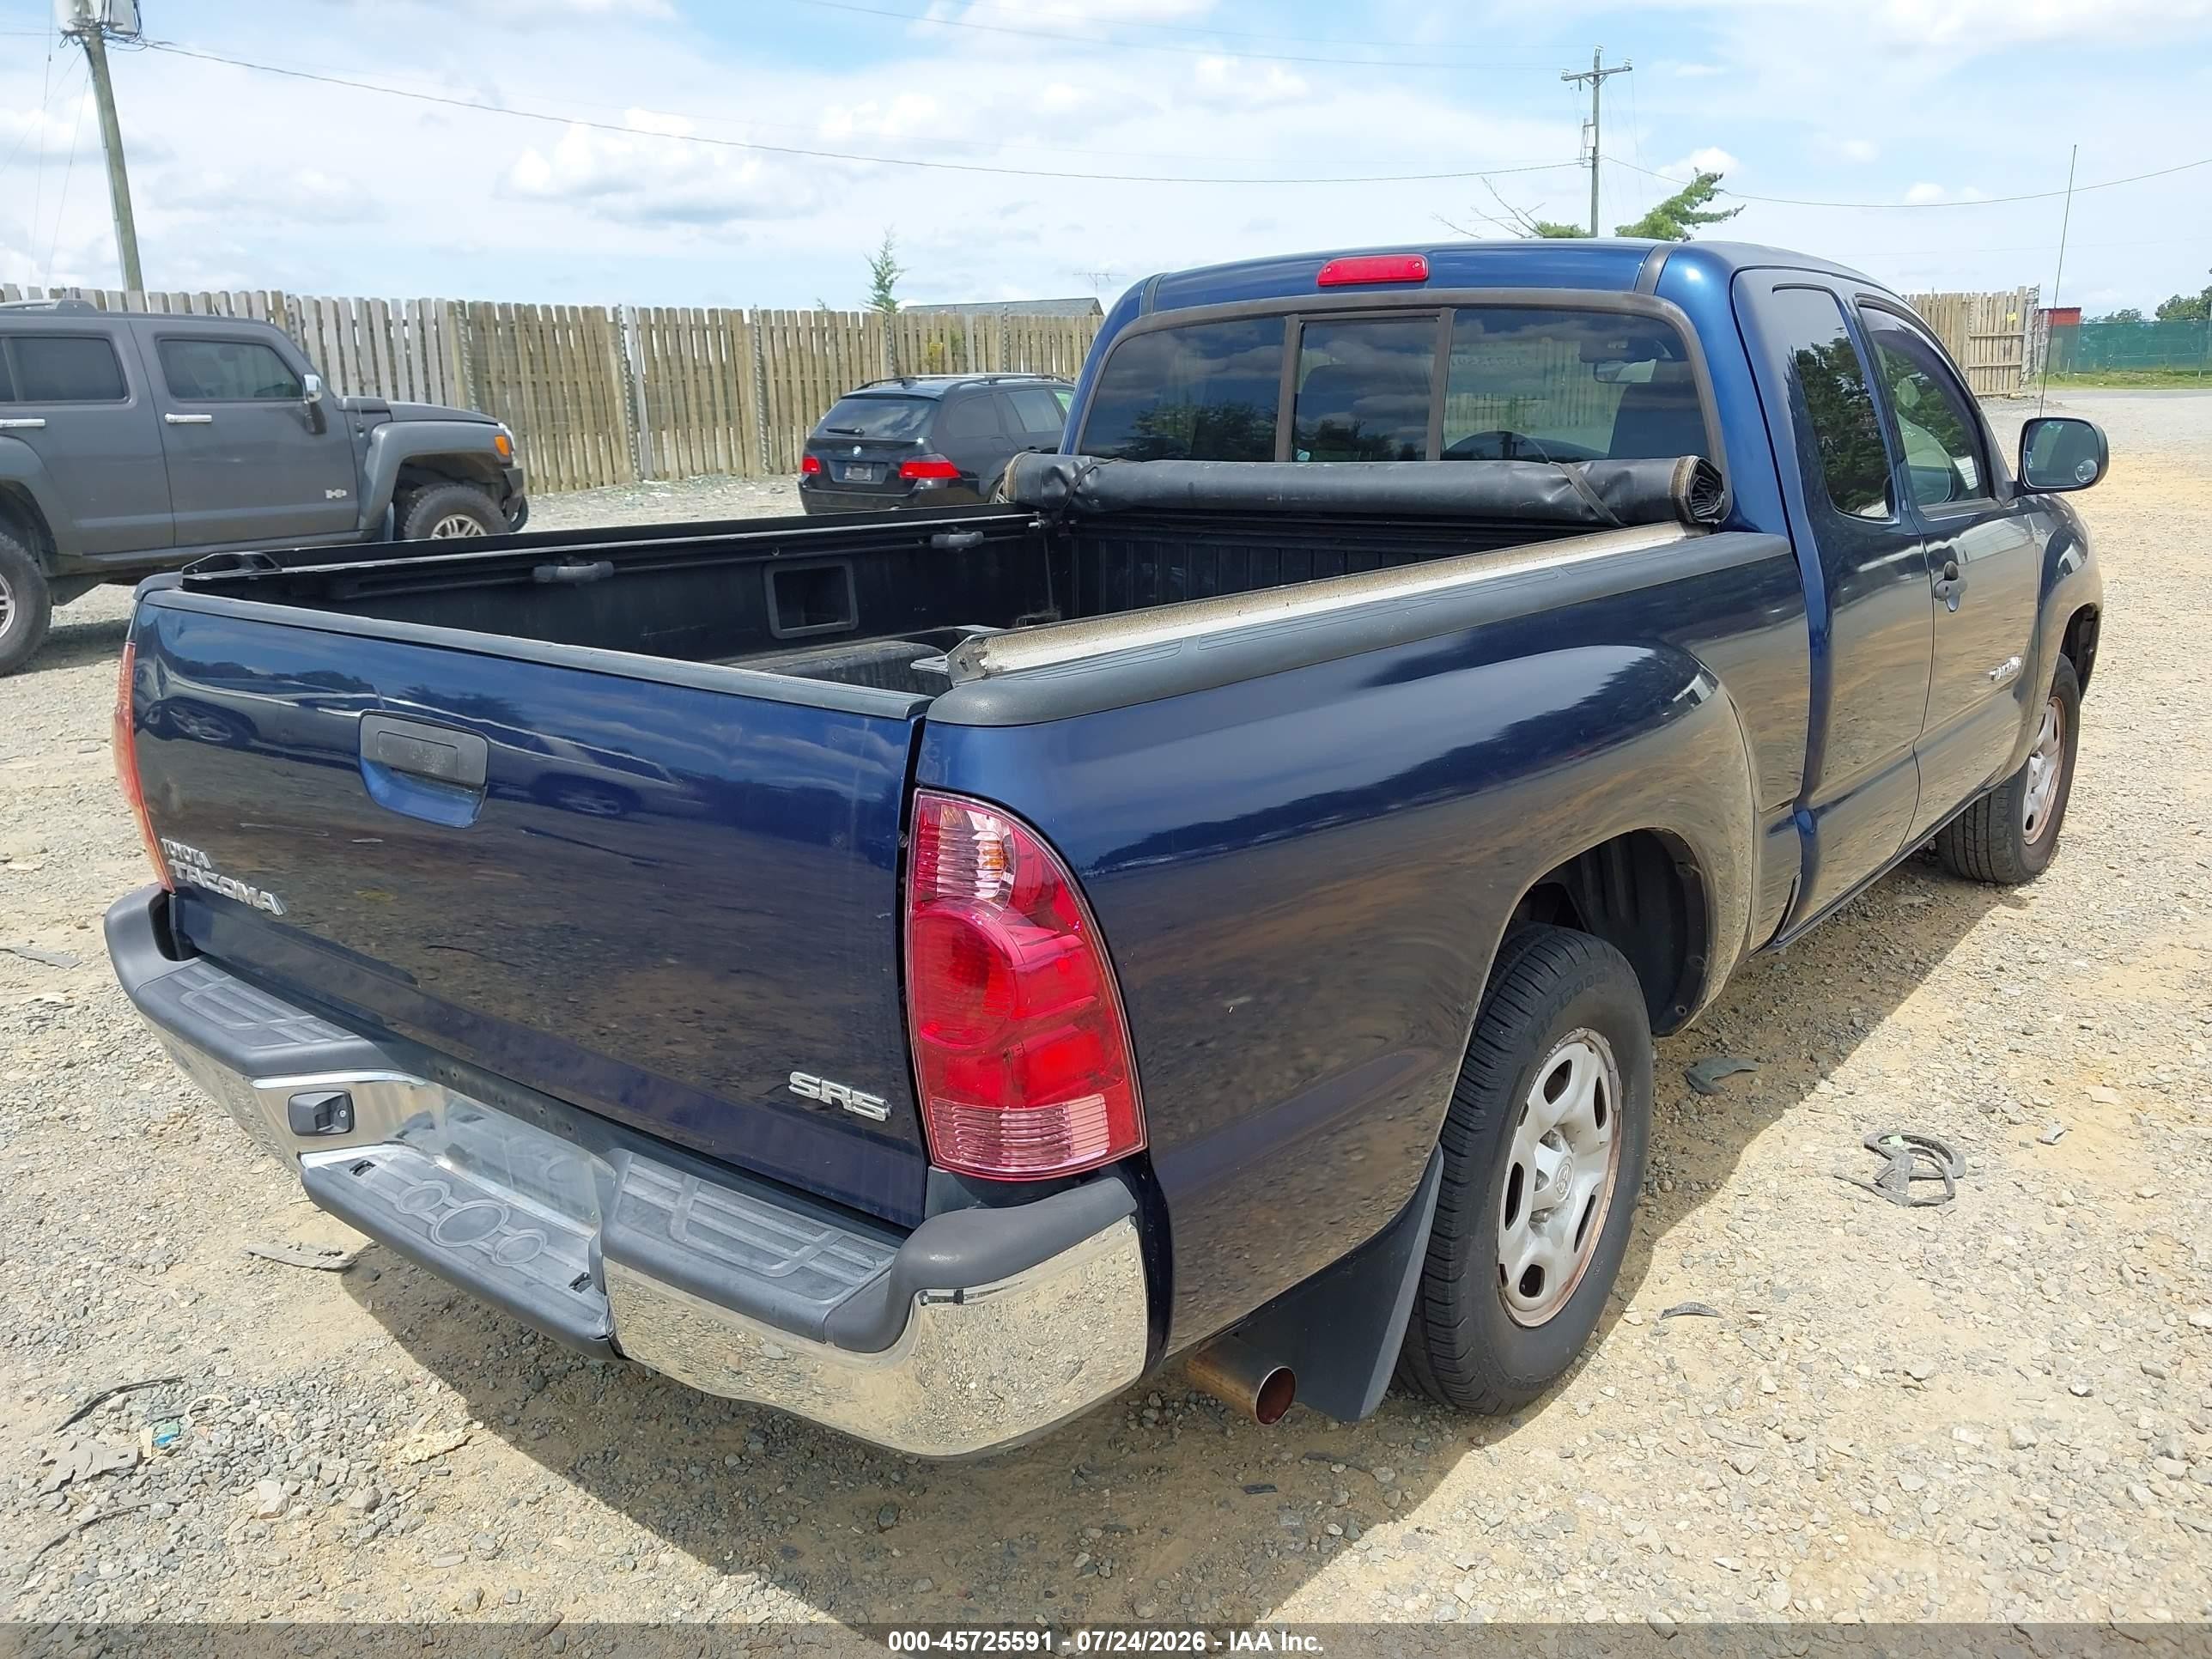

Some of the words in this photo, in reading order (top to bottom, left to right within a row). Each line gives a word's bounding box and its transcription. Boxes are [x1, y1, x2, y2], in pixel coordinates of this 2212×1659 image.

[160, 837, 212, 869] TOYOTA
[168, 859, 286, 916] TACOMA
[788, 1071, 889, 1121] SR5
